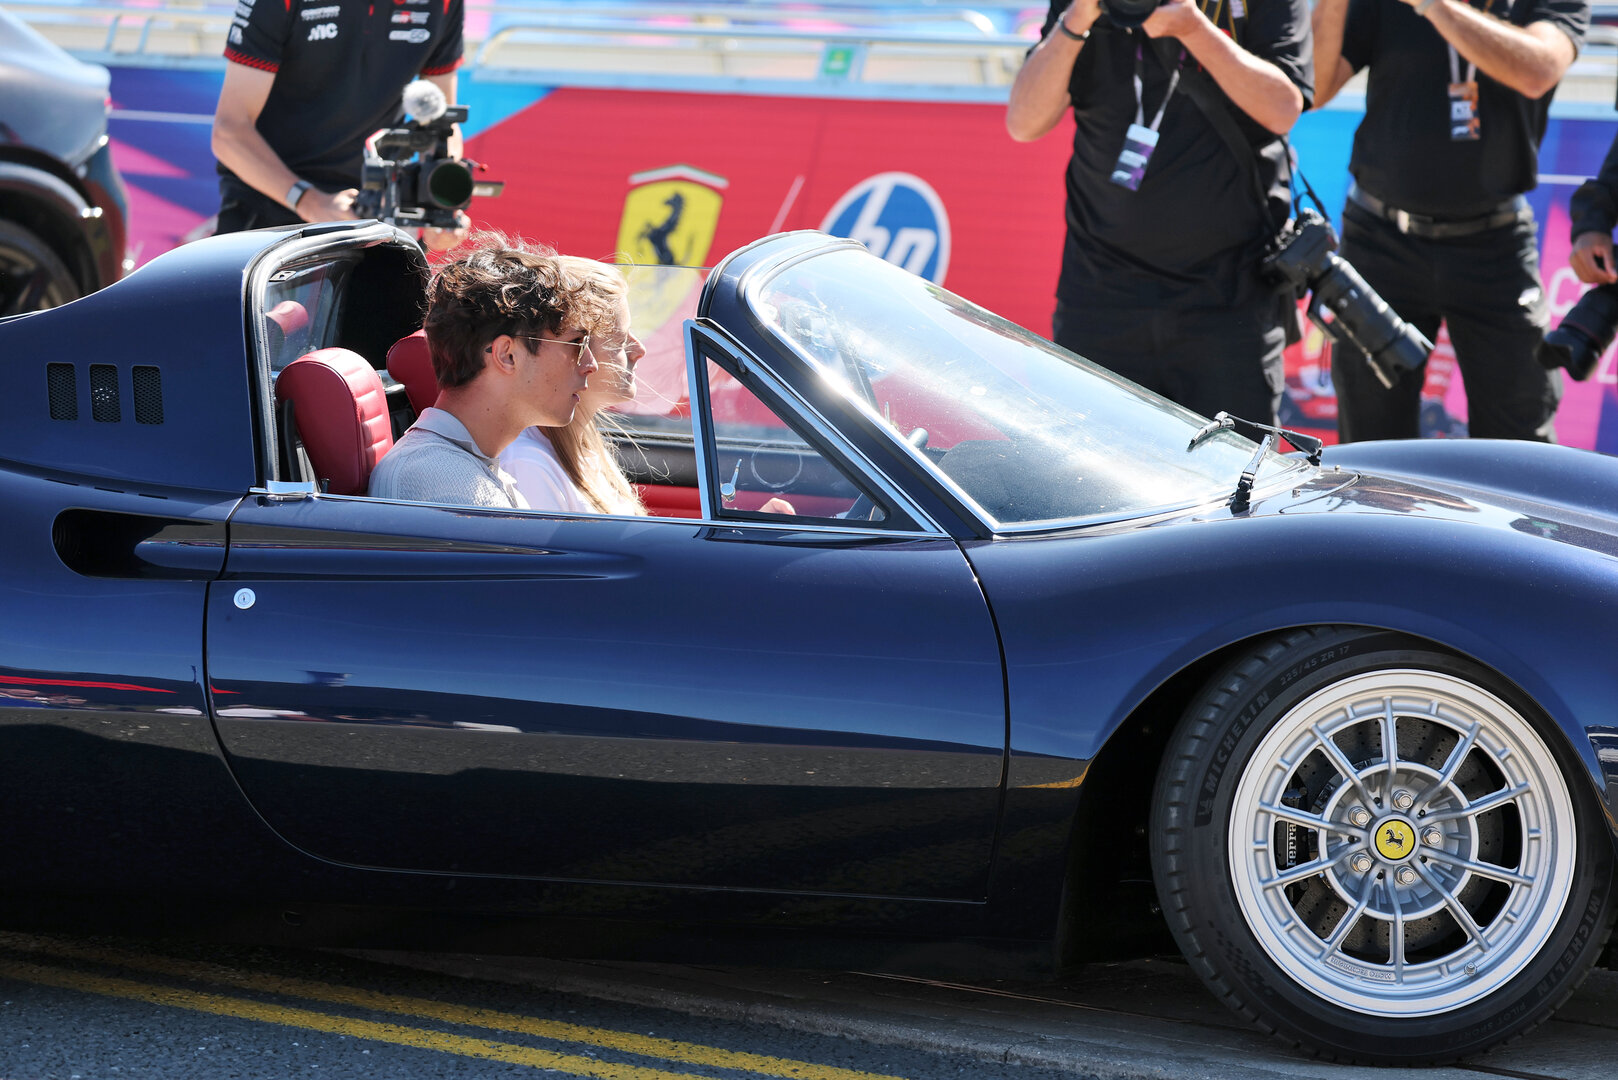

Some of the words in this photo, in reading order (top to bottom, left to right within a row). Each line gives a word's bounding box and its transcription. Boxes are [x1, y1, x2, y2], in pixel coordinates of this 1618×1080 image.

[1280, 658, 1317, 686] 225/45
[1320, 650, 1335, 662] ZR
[1339, 645, 1350, 655] 17
[1204, 691, 1270, 793] MICHELIN
[1536, 894, 1600, 996] MICHELIN
[1458, 1021, 1493, 1040] SPORT
[1495, 1001, 1526, 1026] PILOT
